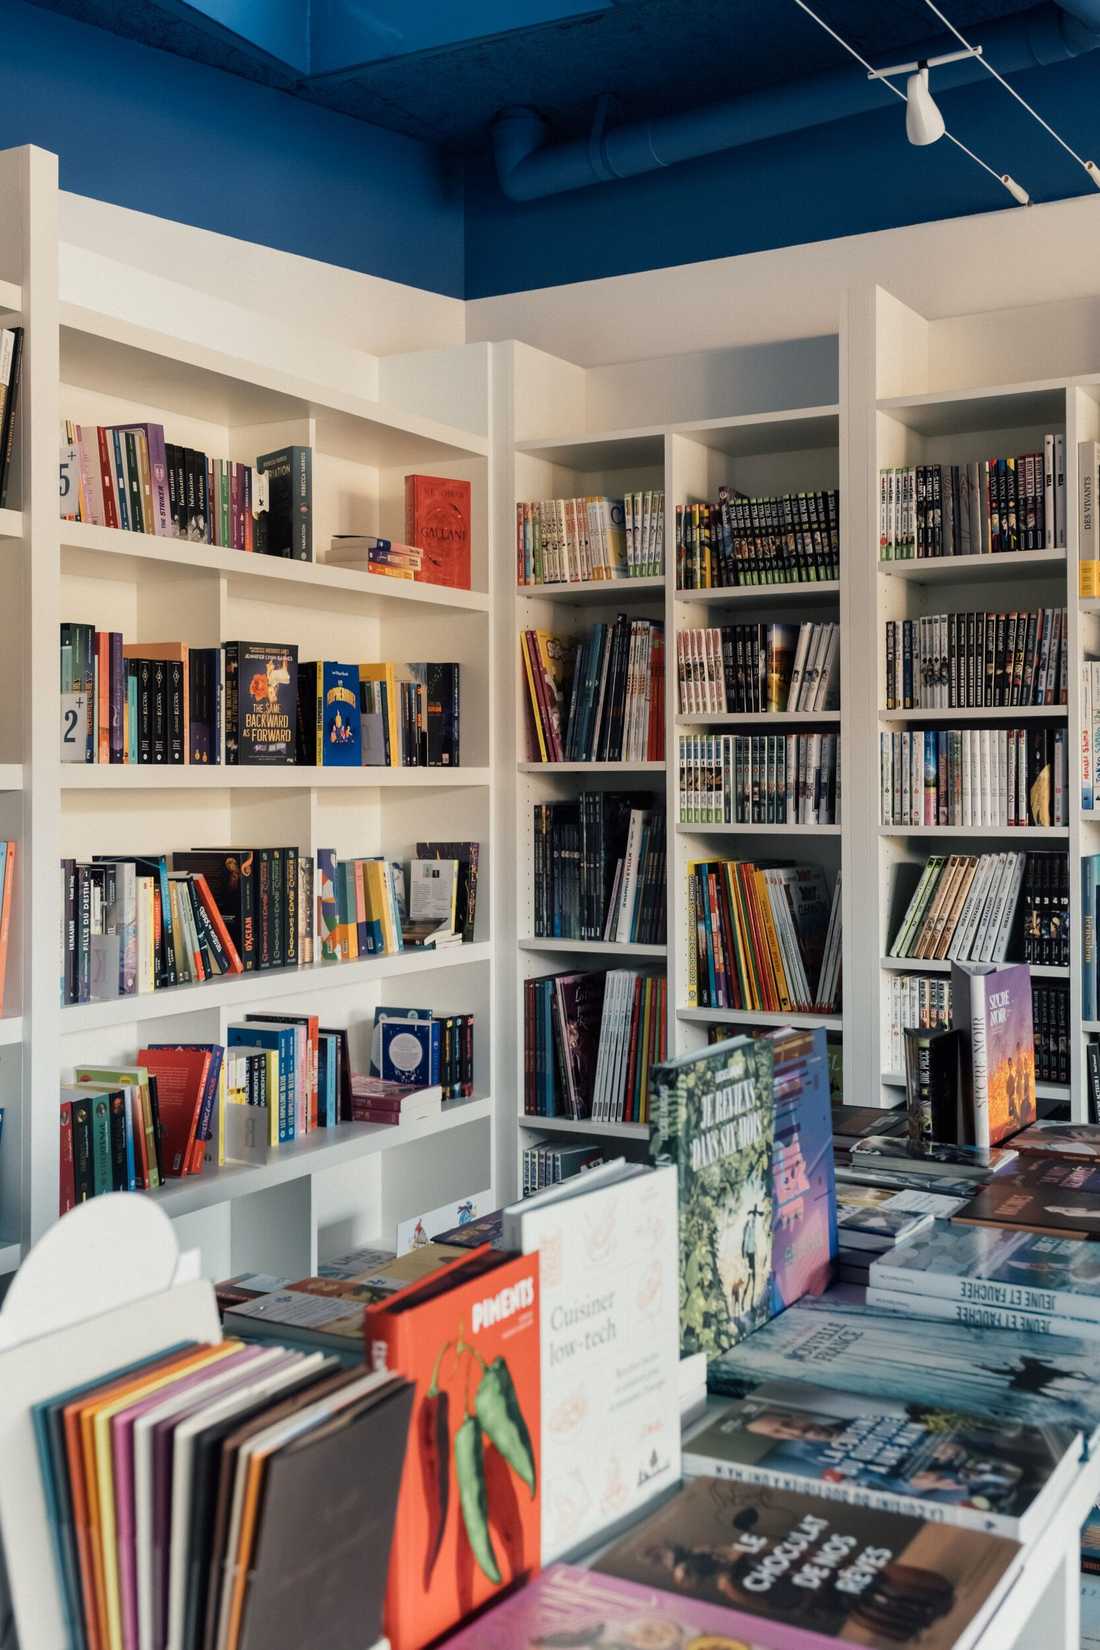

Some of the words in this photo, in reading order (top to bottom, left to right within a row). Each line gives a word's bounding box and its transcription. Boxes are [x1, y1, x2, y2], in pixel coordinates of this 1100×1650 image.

[158, 485, 166, 517] STRIKER
[1084, 476, 1092, 509] VIVANTS
[1084, 511, 1092, 530] DES
[253, 704, 264, 713] THE
[265, 704, 281, 713] SAME
[245, 713, 288, 728] BACKWARD
[243, 729, 250, 738] AS
[251, 729, 291, 742] FORWARD
[82, 912, 89, 925] DU
[988, 990, 1011, 1010] SUCRE
[990, 1008, 1009, 1026] NOIR
[973, 1016, 986, 1056] NOIR
[919, 1050, 930, 1070] PIECE
[919, 1070, 930, 1084] ONE
[974, 1057, 988, 1109] SUCRE
[715, 1078, 756, 1123] REVIENS
[689, 1129, 719, 1172] DANS
[471, 1276, 535, 1334] PIMENTS
[1009, 1289, 1022, 1306] ET
[1023, 1291, 1056, 1311] JEUNE
[550, 1291, 618, 1333] Cuisiner
[1004, 1312, 1017, 1329] ET
[1019, 1315, 1051, 1334] JEUNE
[548, 1316, 618, 1365] low-tech
[731, 1531, 768, 1555] LE
[743, 1513, 830, 1592] CHOCOLAT
[792, 1562, 828, 1590] DE
[813, 1533, 858, 1577] NOS
